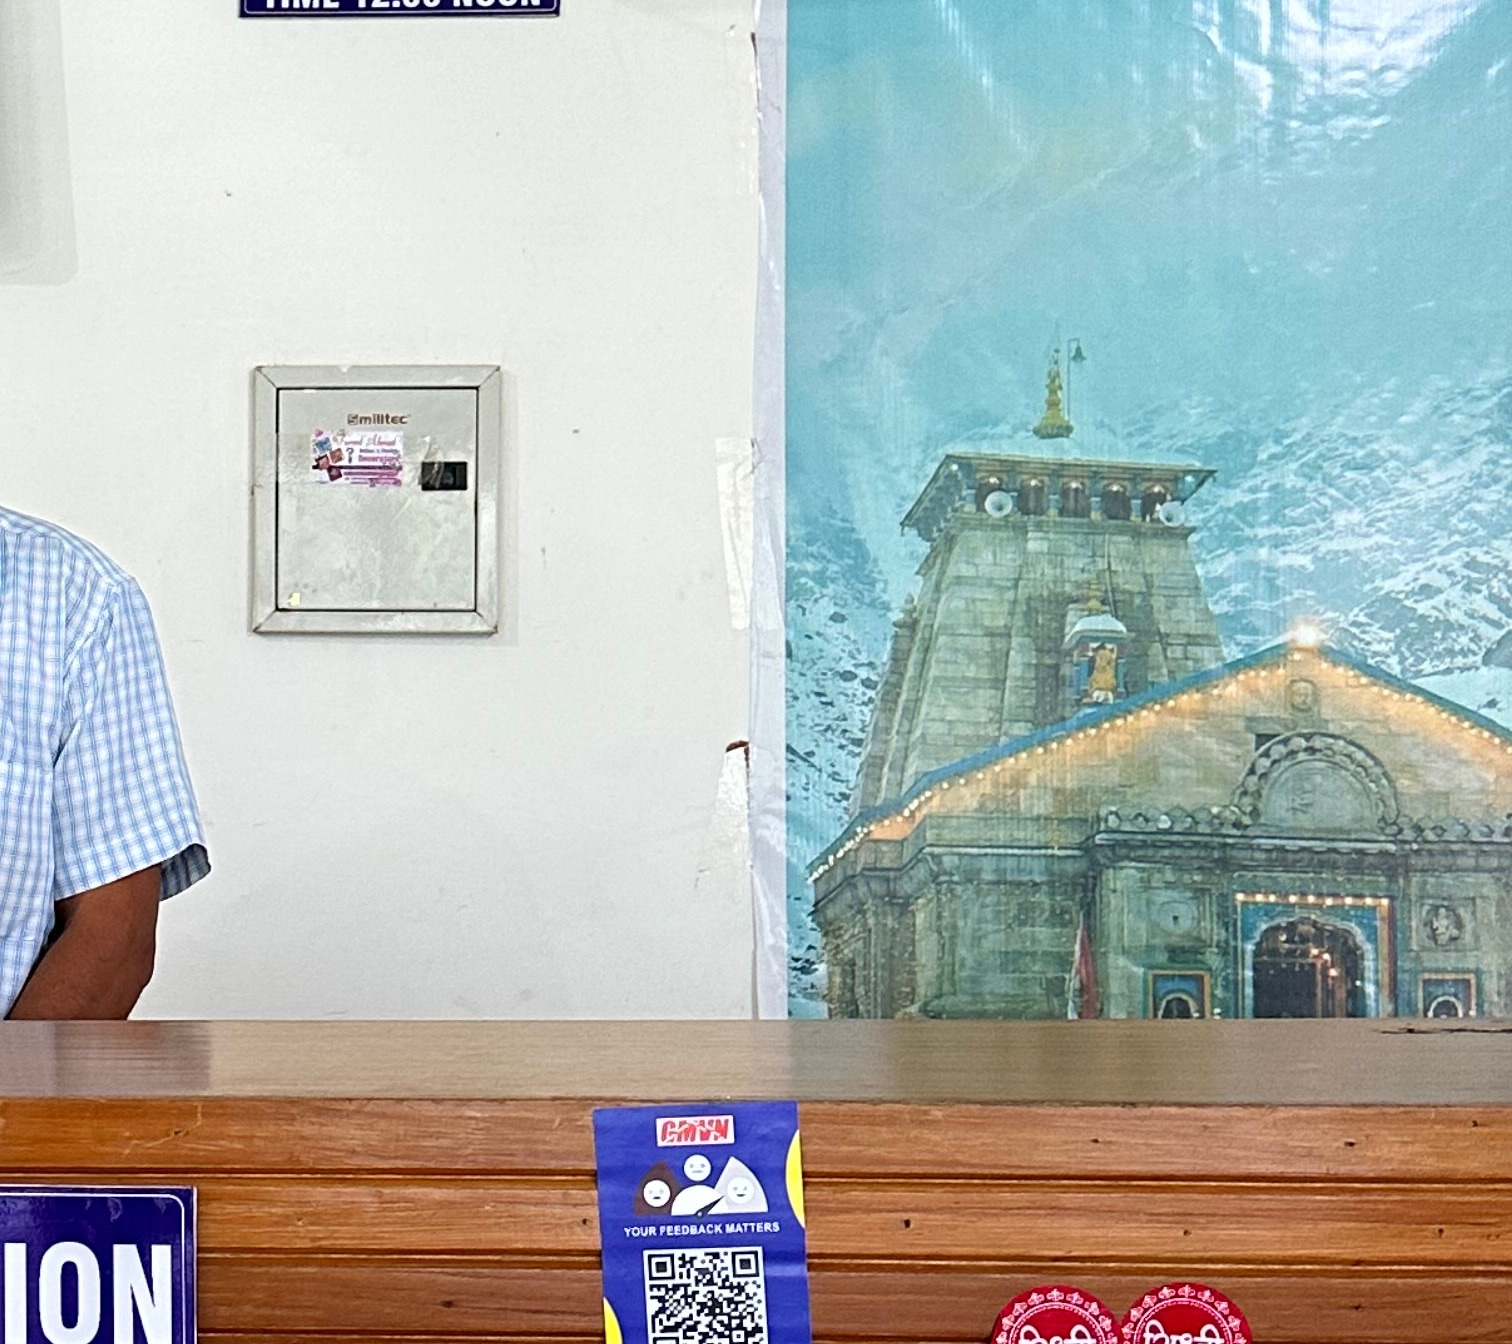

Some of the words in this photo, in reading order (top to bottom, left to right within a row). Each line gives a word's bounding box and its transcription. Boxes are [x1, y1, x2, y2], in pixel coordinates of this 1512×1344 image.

[660, 1118, 729, 1143] GMVN
[623, 1225, 657, 1238] YOUR
[659, 1223, 723, 1237] FEEDBACK
[725, 1221, 780, 1234] MATTERS
